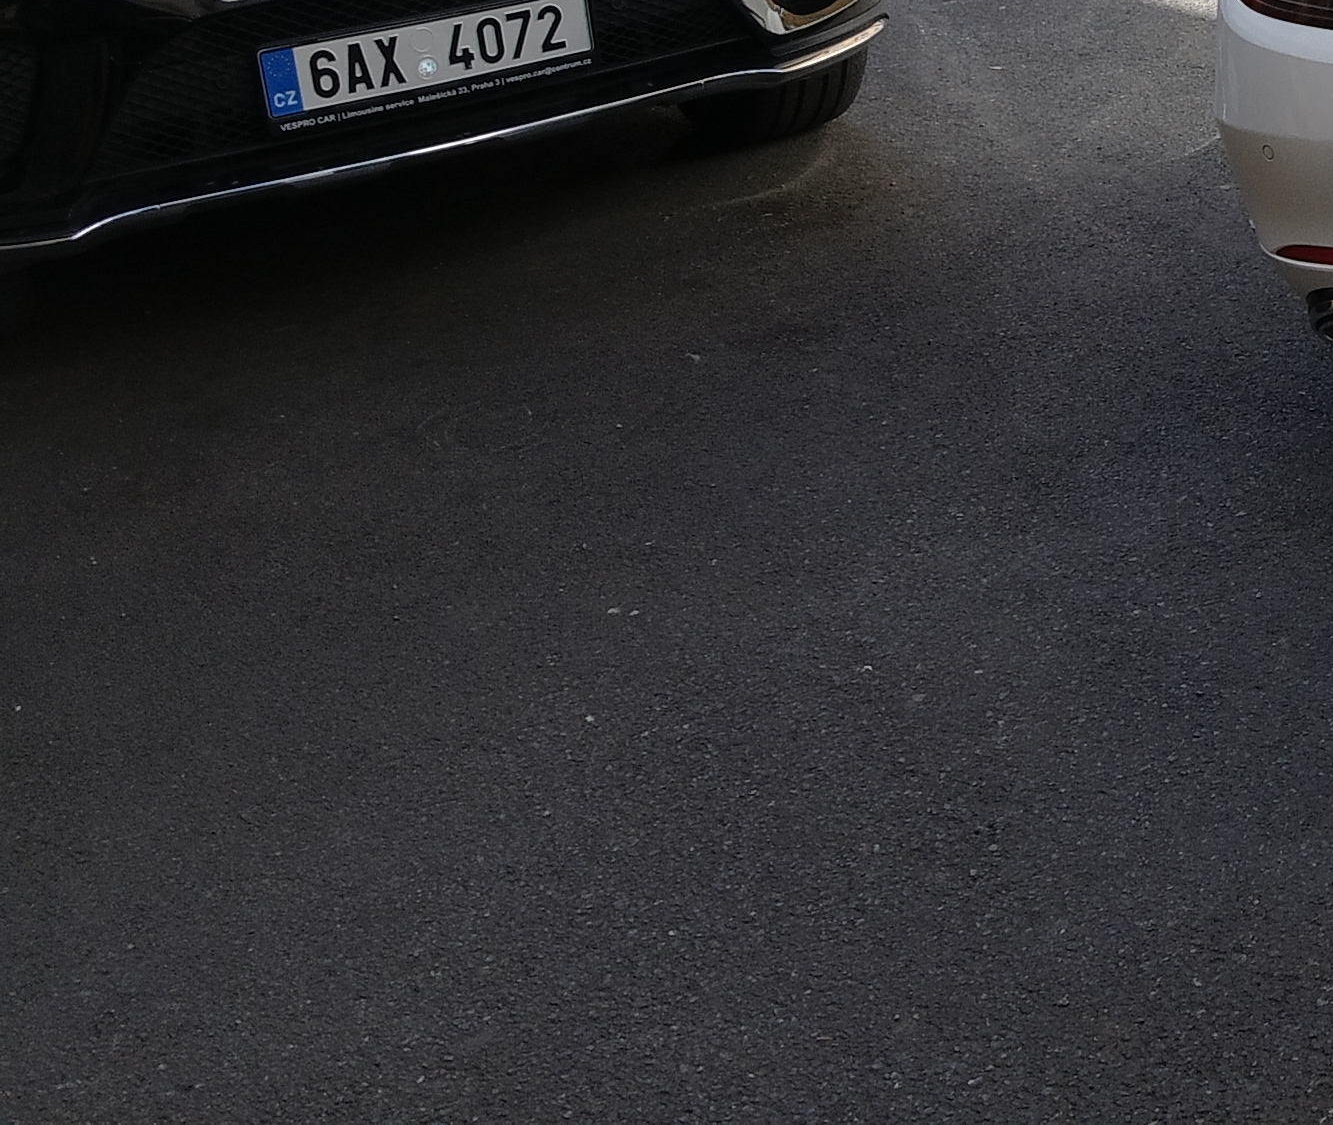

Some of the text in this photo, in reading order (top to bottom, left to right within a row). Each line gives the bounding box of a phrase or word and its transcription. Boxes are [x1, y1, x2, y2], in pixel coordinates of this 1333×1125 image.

[309, 4, 568, 99] 6AX 4072
[273, 90, 298, 108] CZ
[279, 118, 316, 132] VESPRO
[316, 113, 337, 125] CAR
[341, 104, 385, 120] Limousine
[385, 98, 415, 111] service
[471, 80, 494, 93] Praha
